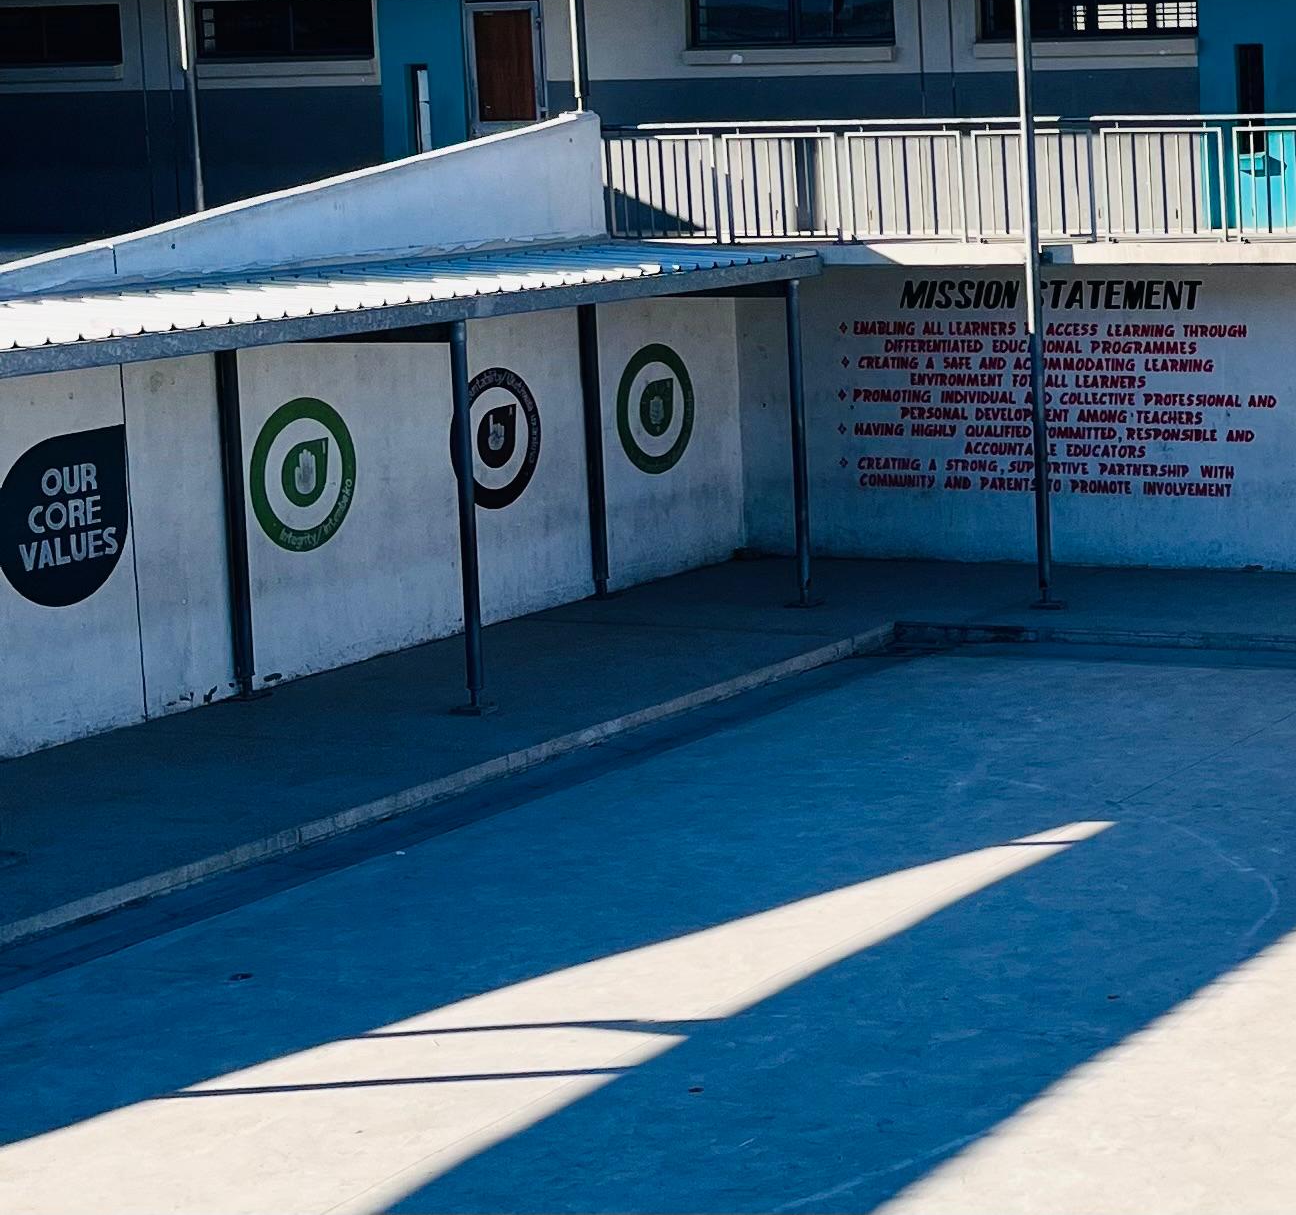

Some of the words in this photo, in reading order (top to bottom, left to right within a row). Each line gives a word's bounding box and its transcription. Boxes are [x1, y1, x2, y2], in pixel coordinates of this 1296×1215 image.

[900, 280, 1020, 309] MISSION
[853, 321, 915, 335] ENABLING
[923, 321, 944, 335] ALL
[949, 321, 1016, 336] LEARNERS
[1046, 323, 1098, 337] ACCESS
[1107, 324, 1175, 337] LEARNING
[1183, 324, 1247, 338] THROUGH
[884, 339, 984, 353] DIFFERENTIATED
[992, 339, 1082, 355] EDUCIONAL
[1091, 340, 1197, 355] PROGRAMMES
[858, 356, 919, 370] CREATING
[925, 357, 934, 370] A
[943, 356, 972, 370] SAFE
[979, 357, 1007, 370] AND
[1013, 357, 1135, 372] ACMMODATING
[1144, 359, 1214, 373] LEARNING
[910, 373, 1003, 387] ENVIRONMENT
[1045, 374, 1067, 388] ALL
[1075, 375, 1146, 389] LEARNERS
[853, 389, 931, 403] PROMOTING
[940, 390, 1016, 405] INDIVIDUAL
[1024, 391, 1052, 405] AD
[1060, 392, 1136, 406] COLLECTIVE
[1143, 393, 1242, 408] PROFESSIONAL
[1248, 394, 1277, 409] AND
[900, 407, 968, 421] PERSONAL
[975, 408, 1069, 423] DEVELOPENT
[1077, 409, 1127, 424] AMONG
[1136, 410, 1203, 425] TEACHERS
[854, 423, 904, 436] HAVING
[911, 424, 956, 437] HIGHLY
[965, 424, 1032, 438] QUALIFIED
[1044, 426, 1123, 442] OMMITTED,
[1126, 427, 1217, 442] RESPONSIBLE
[1226, 429, 1255, 442] AND
[964, 441, 1057, 456] ACCOUNTAE
[1066, 443, 1146, 458] EDUCATORS
[857, 457, 921, 471] CREATING
[929, 459, 937, 471] A
[1098, 462, 1189, 478] PARTNERSHIP
[1200, 465, 1235, 479] WITH
[41, 462, 98, 496] OUR
[859, 473, 935, 488] COMMUNITY
[944, 476, 971, 490] AND
[979, 476, 1038, 492] PARENTS
[1069, 480, 1132, 495] PROMOTE
[1143, 481, 1232, 497] INVOLVEMENT
[28, 495, 101, 533] CORE
[19, 526, 119, 572] VALUES
